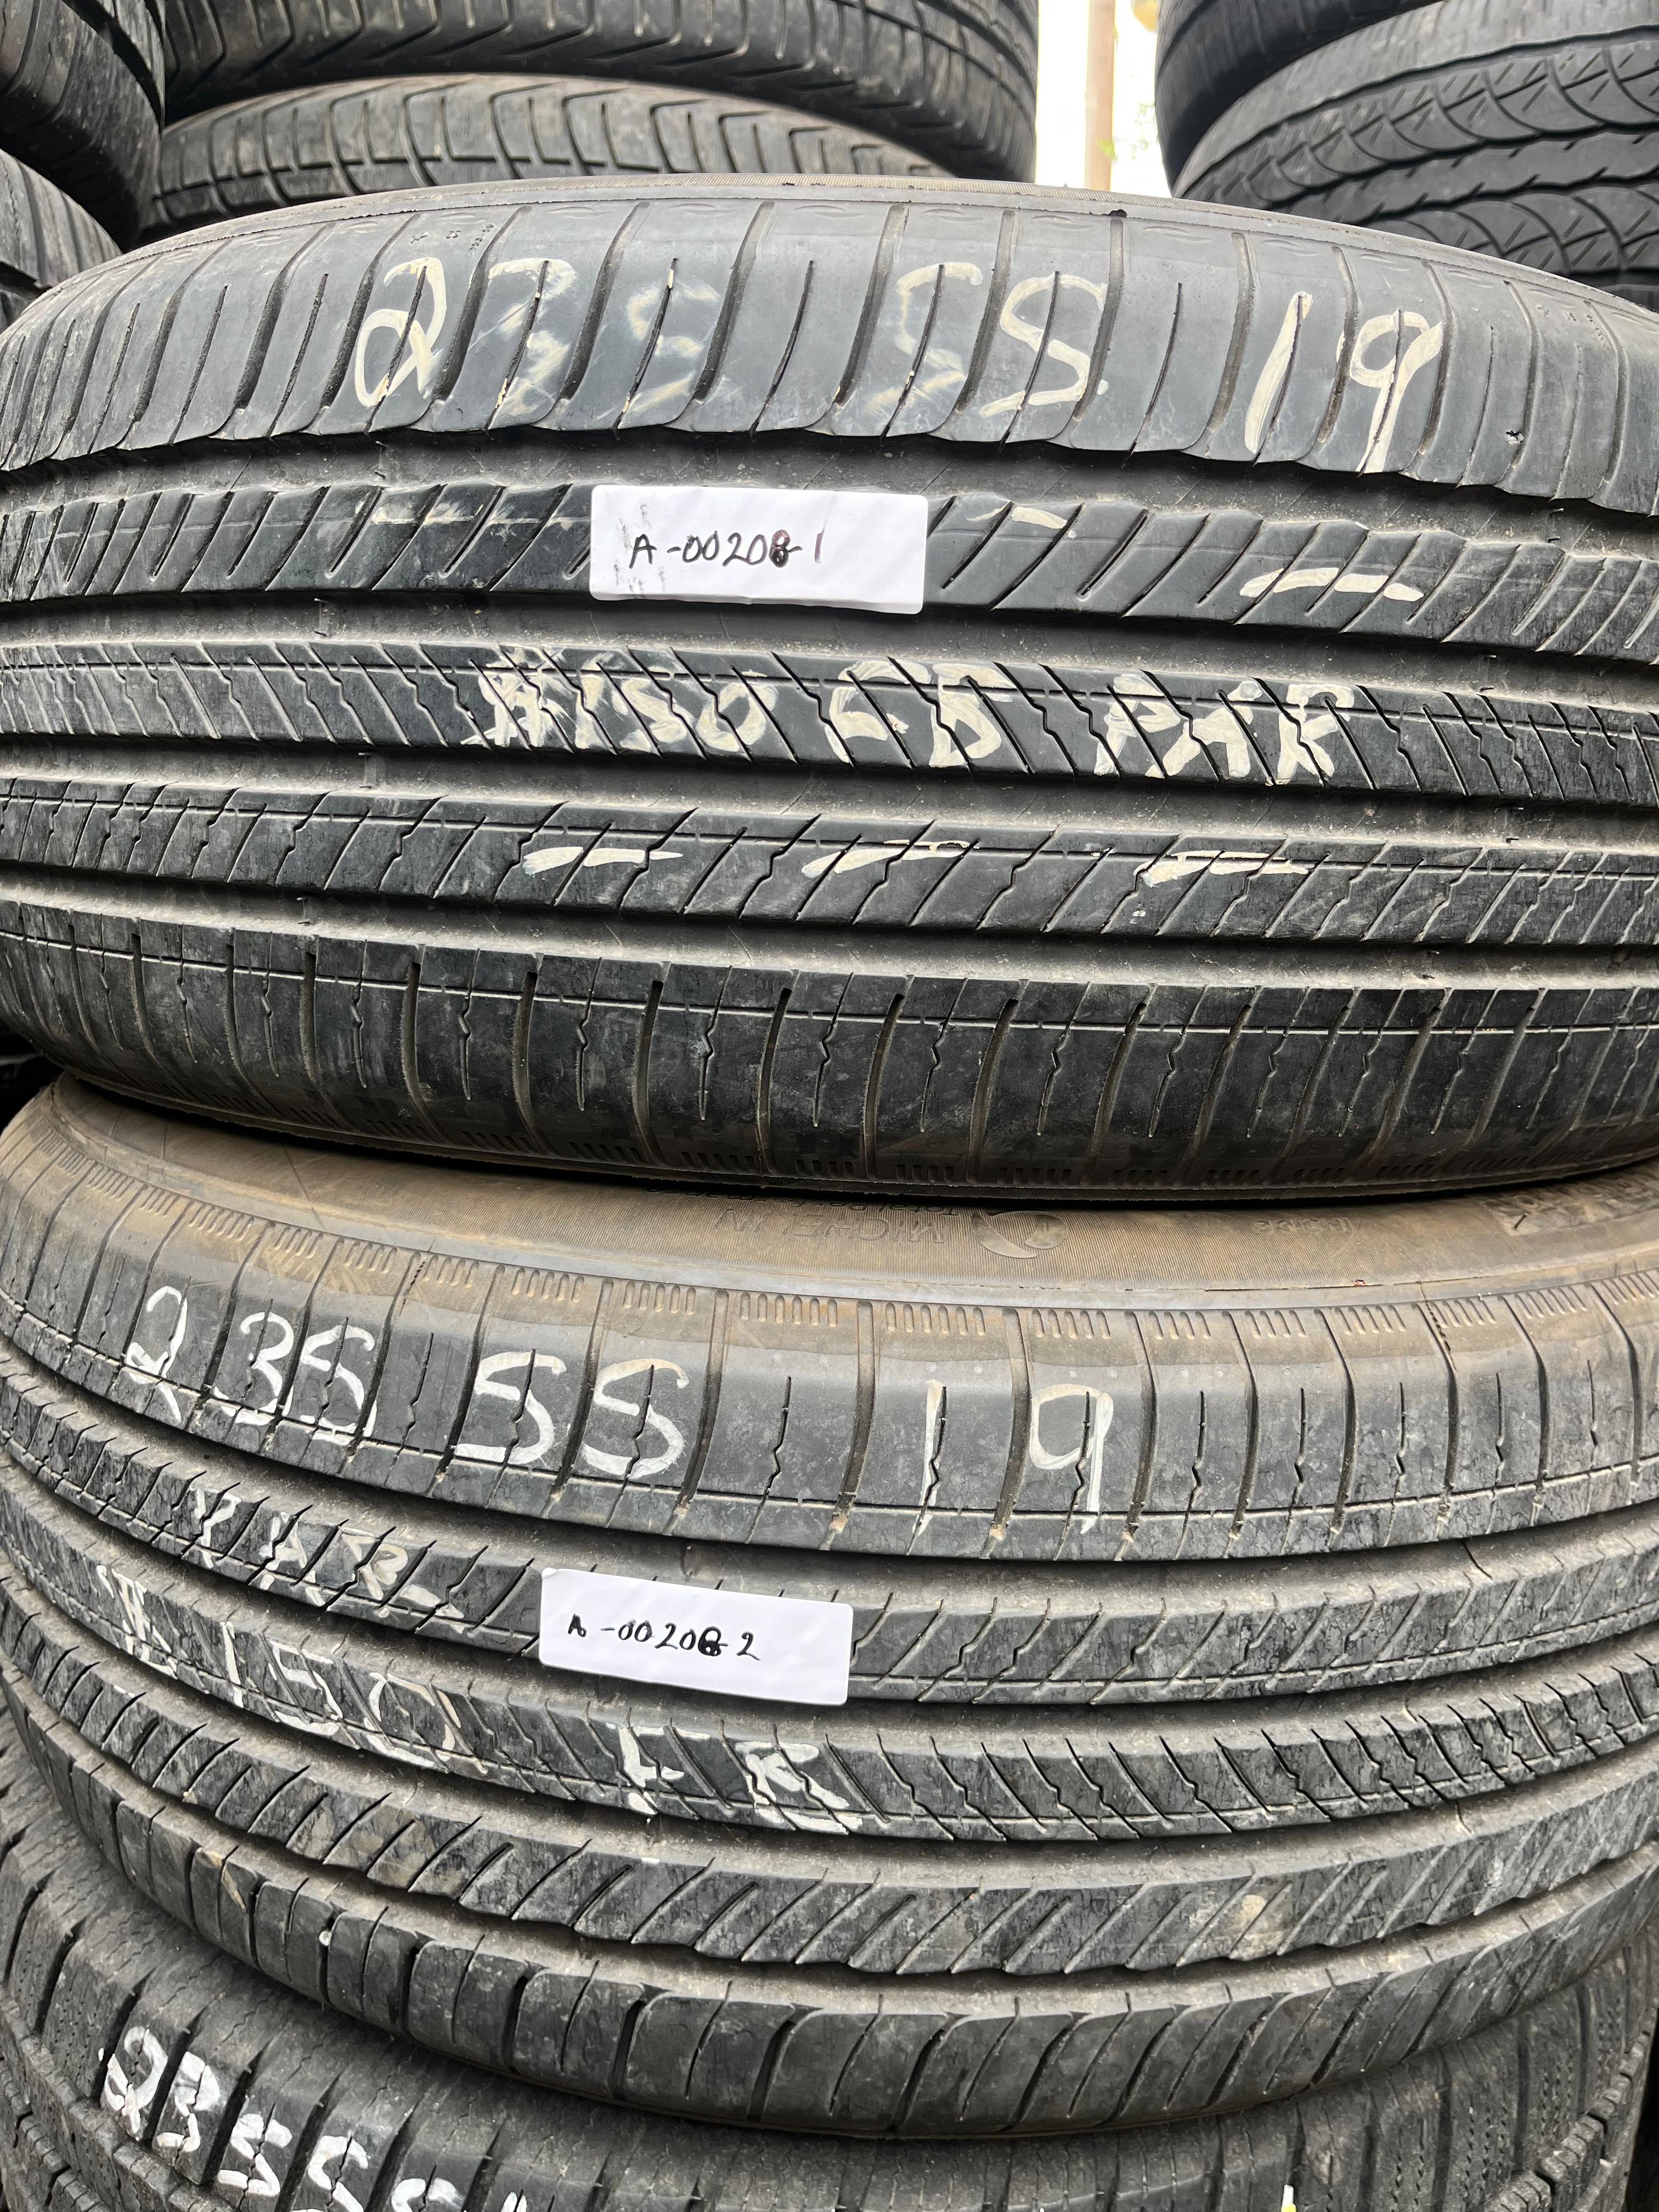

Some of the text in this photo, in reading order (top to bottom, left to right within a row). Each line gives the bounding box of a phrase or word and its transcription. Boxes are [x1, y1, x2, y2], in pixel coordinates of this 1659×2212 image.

[865, 261, 1107, 417] 55
[1244, 291, 1443, 473] 19
[124, 1285, 1114, 1536] 235 55 19
[101, 2025, 293, 2197] 235
